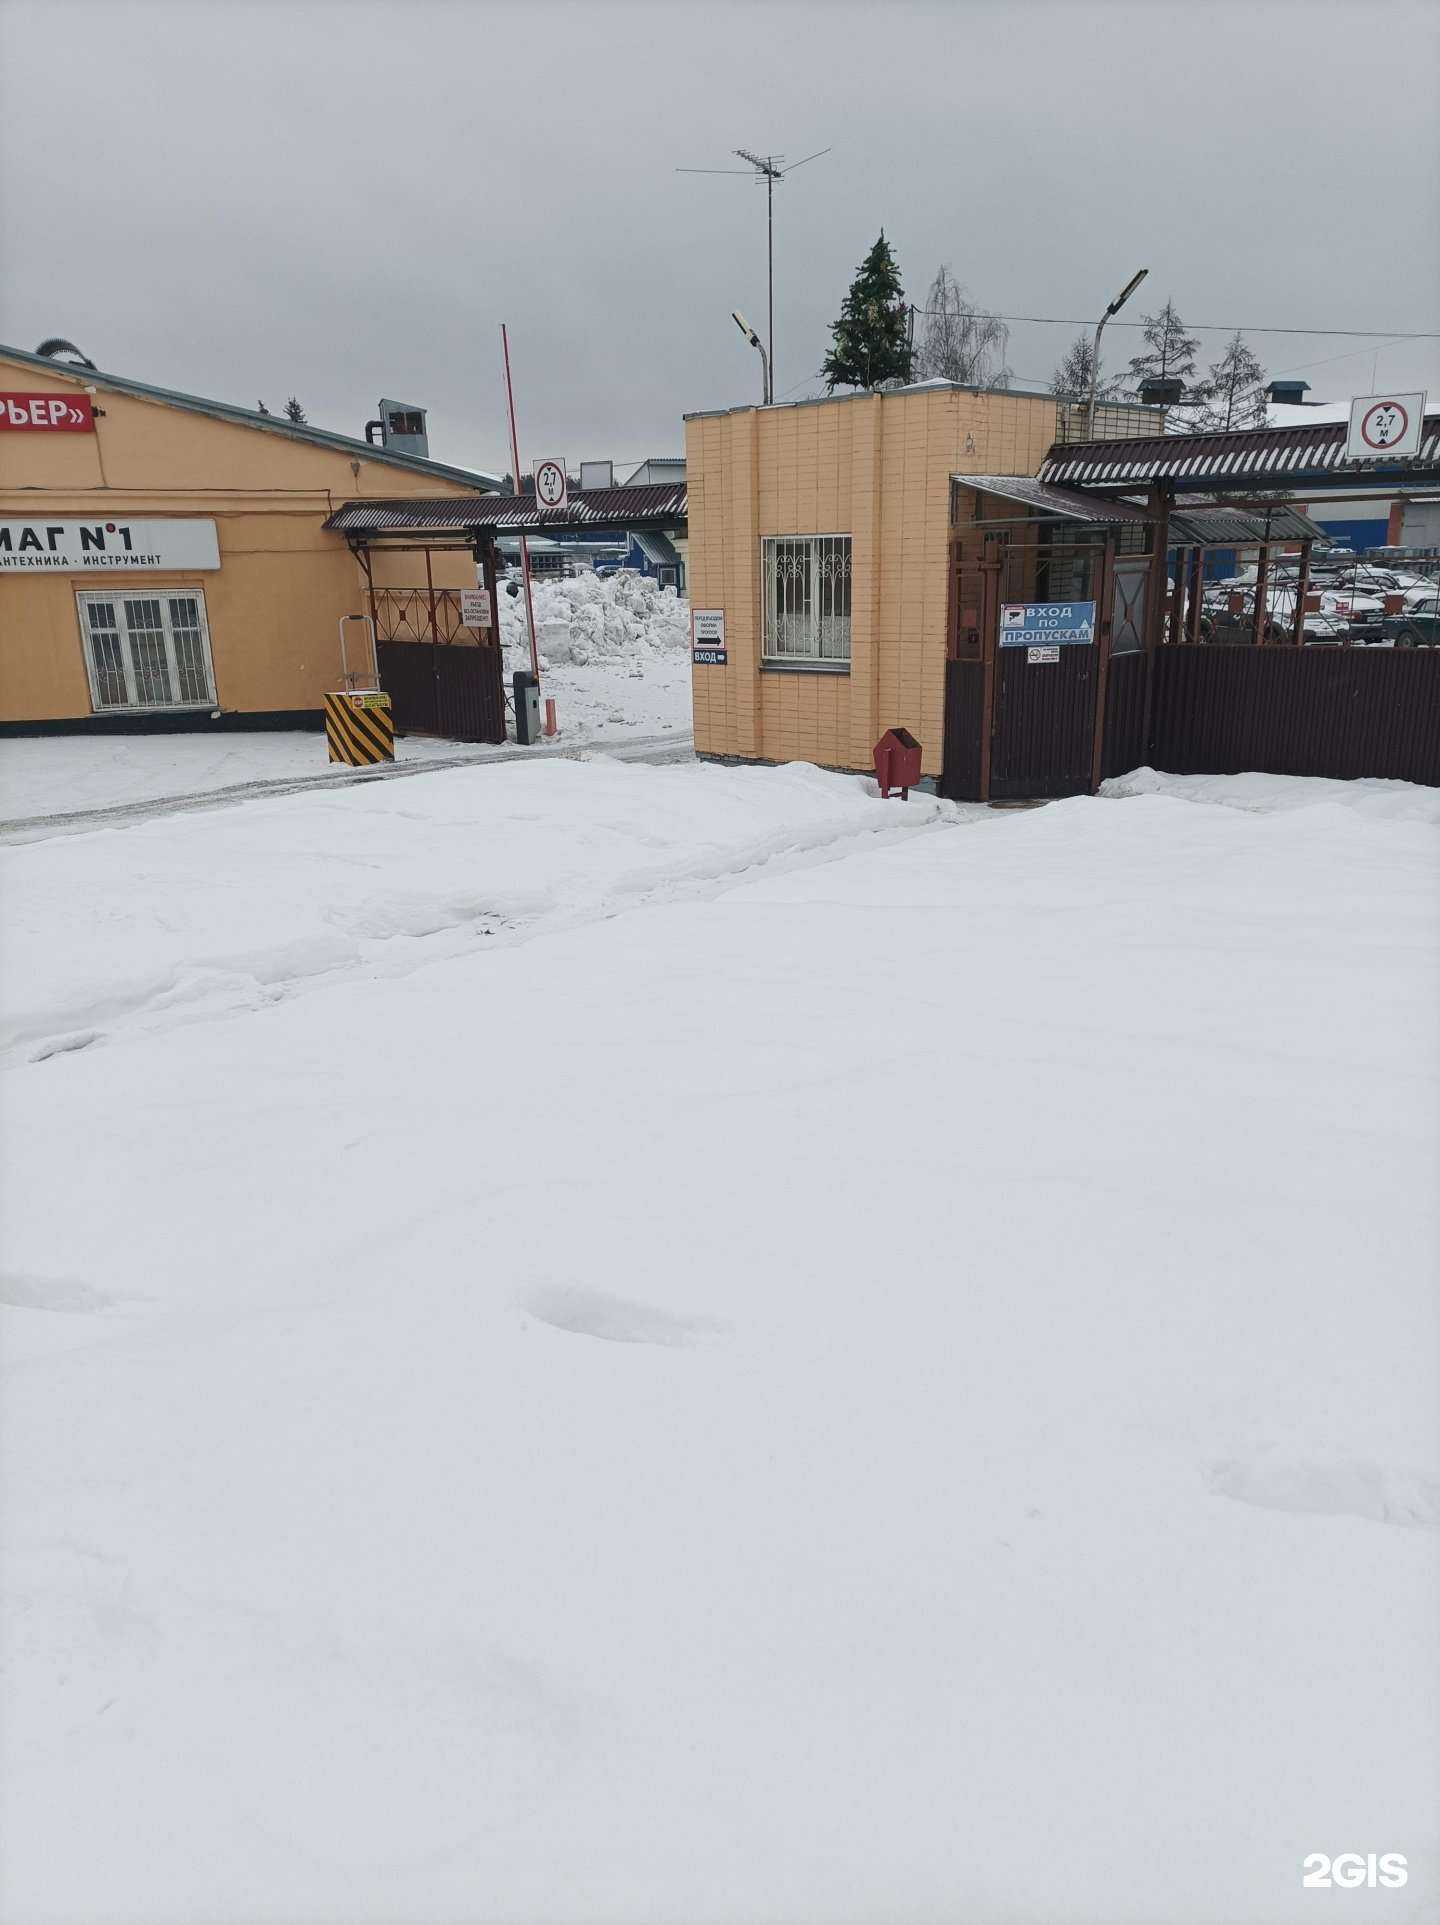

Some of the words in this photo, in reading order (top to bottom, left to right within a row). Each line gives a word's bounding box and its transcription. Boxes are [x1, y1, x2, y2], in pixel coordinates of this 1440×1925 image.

[0, 399, 84, 425] ЬЕР»
[1376, 414, 1396, 428] 2,7
[543, 471, 556, 487] 2,7
[83, 554, 161, 566] ИНСТРУМЕНТ
[1026, 606, 1072, 618] ВХОД
[1039, 619, 1058, 627] ПО
[1004, 629, 1089, 641] ПРОПУСКАМ
[694, 651, 717, 664] ВХОД
